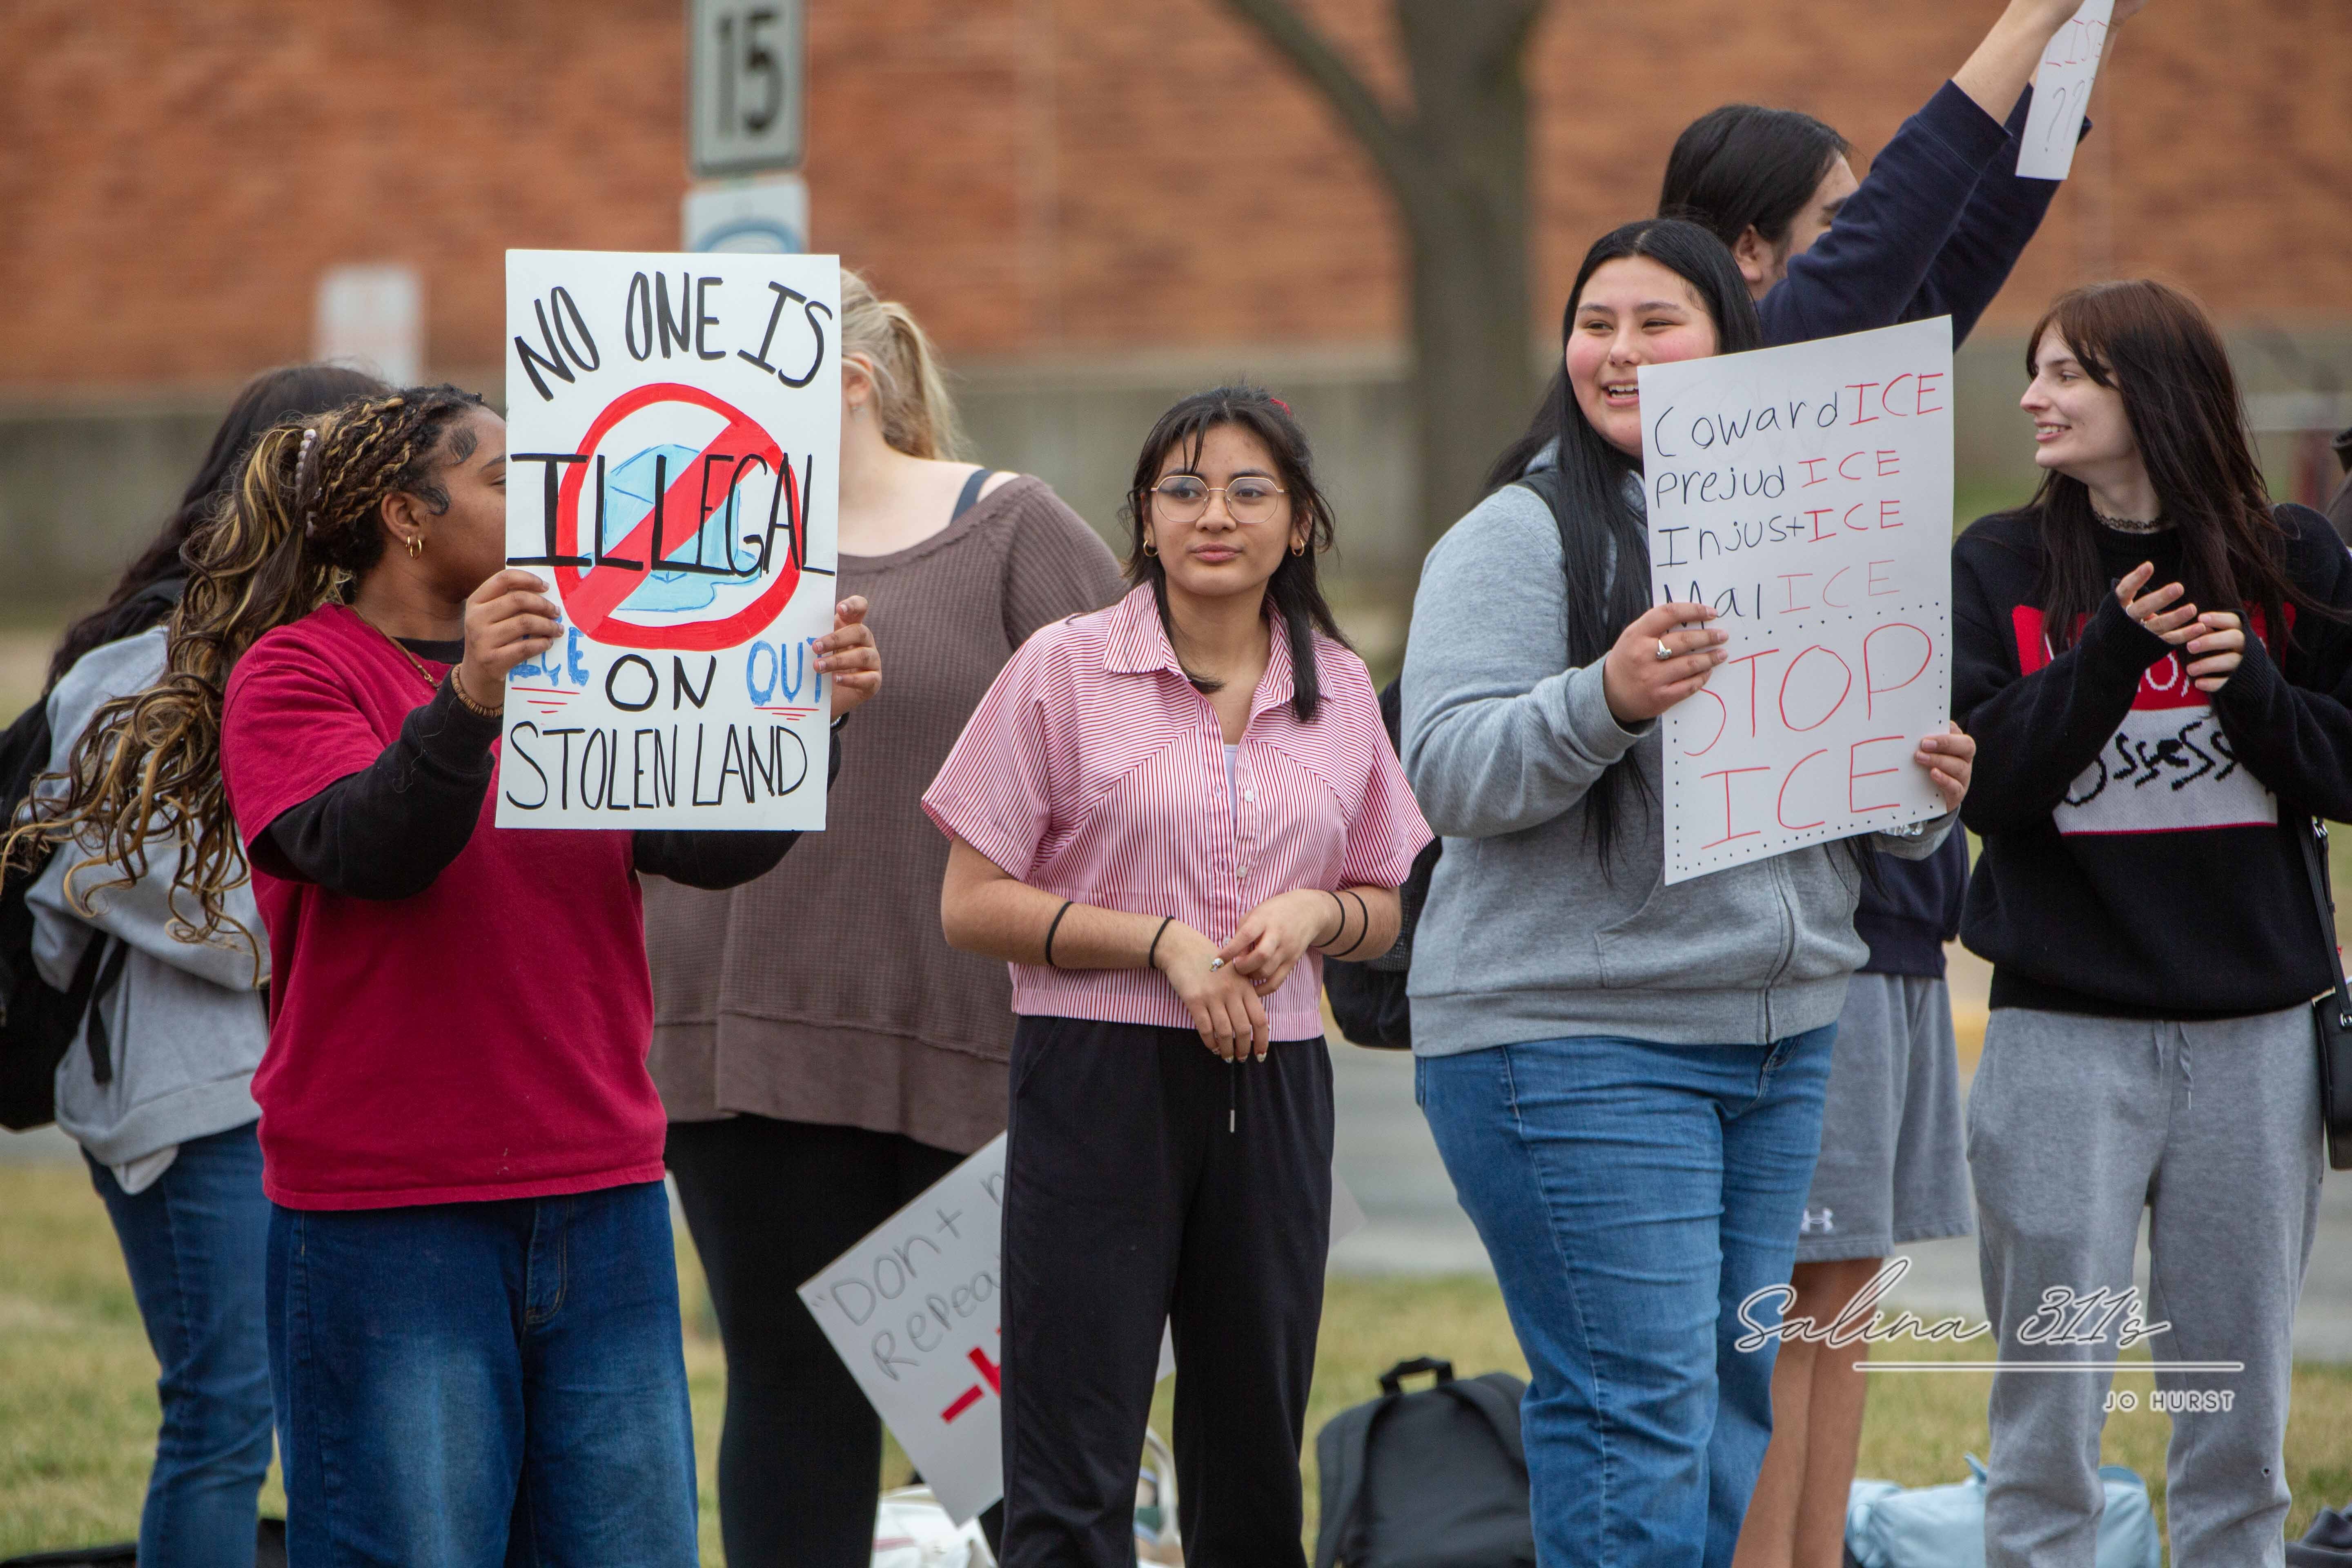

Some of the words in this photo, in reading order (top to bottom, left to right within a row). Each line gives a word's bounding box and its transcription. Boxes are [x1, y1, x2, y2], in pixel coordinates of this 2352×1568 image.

[717, 7, 783, 139] 15
[514, 285, 600, 401] NO
[625, 271, 726, 360] ONE
[738, 280, 833, 388] IS
[506, 452, 835, 577] ILLEGAL
[605, 654, 717, 711] ON
[746, 637, 822, 706] OUT
[507, 721, 677, 811] STOLEN
[693, 722, 808, 807] LAND
[1701, 735, 1905, 850] ICE
[870, 1254, 1001, 1381] Repea
